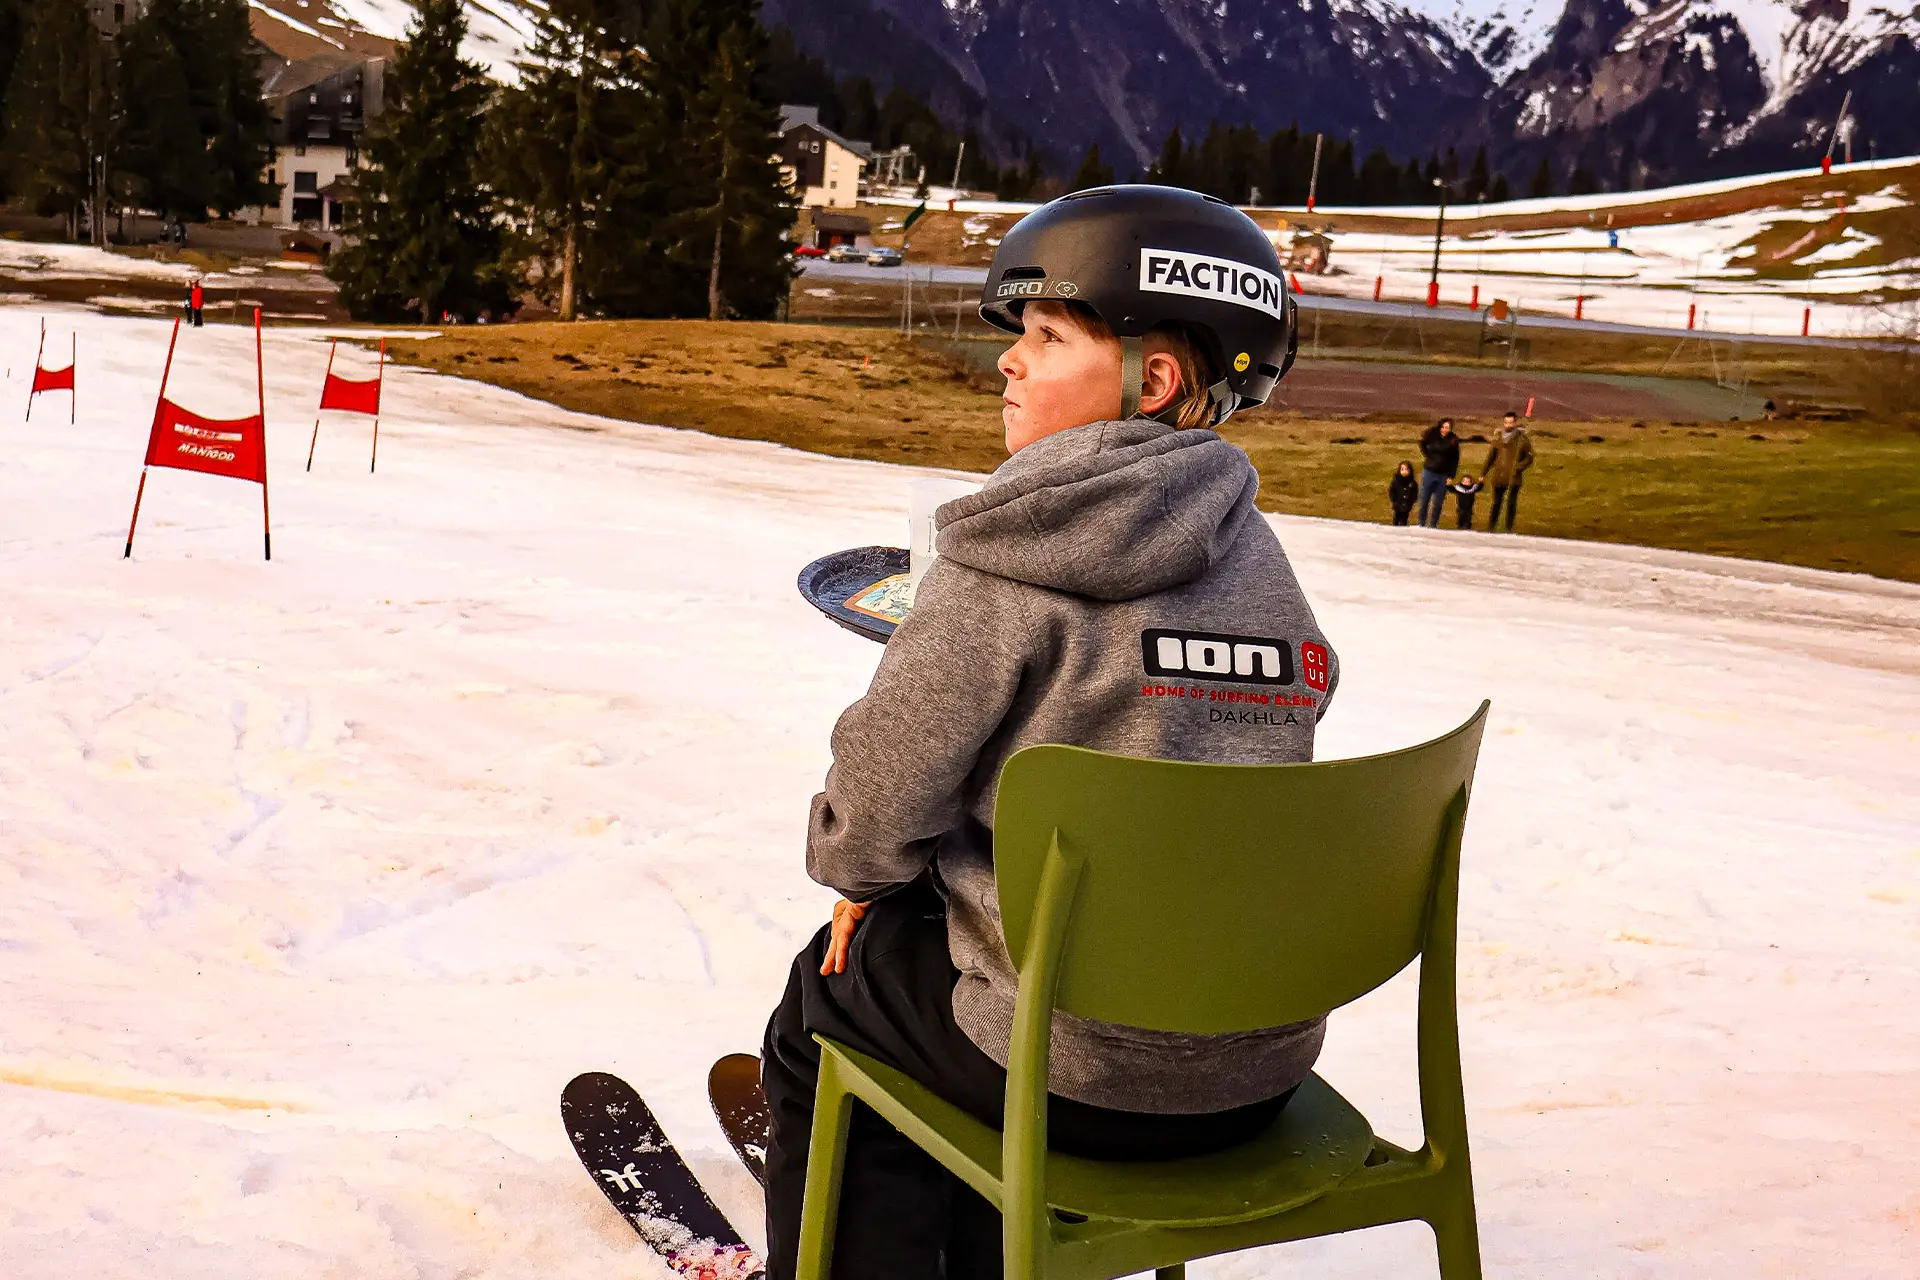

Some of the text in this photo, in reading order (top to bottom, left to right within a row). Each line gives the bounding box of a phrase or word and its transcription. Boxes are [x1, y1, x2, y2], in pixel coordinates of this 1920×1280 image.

[996, 281, 1042, 297] GIRO
[1148, 256, 1279, 310] FACTION
[178, 442, 236, 461] MANIGOD
[1141, 685, 1186, 698] HOME
[1190, 687, 1205, 700] OF
[1209, 709, 1299, 726] DAKHLA
